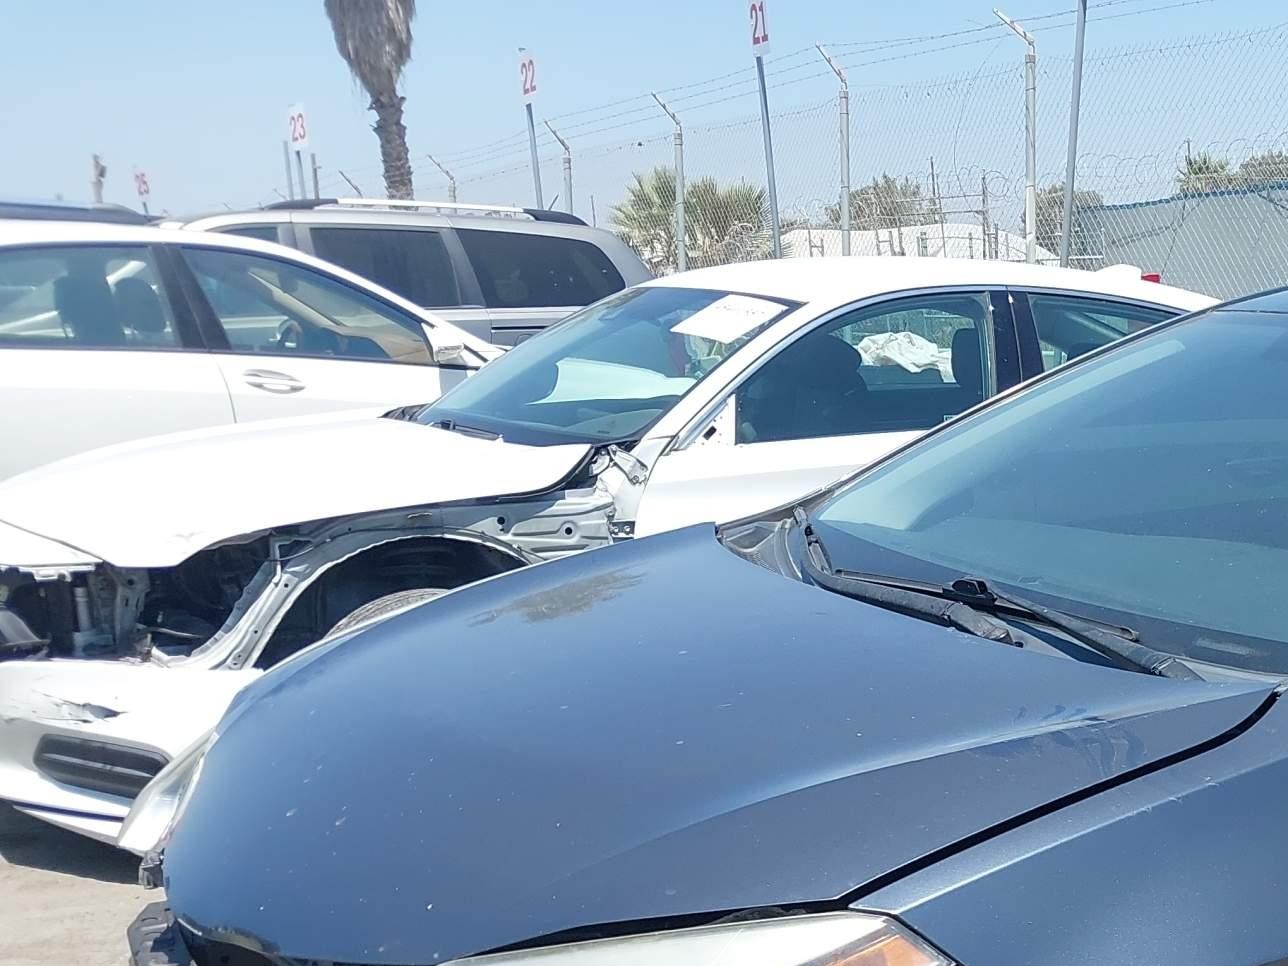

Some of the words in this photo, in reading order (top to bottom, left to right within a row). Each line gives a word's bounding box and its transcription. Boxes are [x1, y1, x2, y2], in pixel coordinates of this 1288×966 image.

[750, 1, 769, 45] 21
[520, 59, 537, 96] 22
[289, 112, 306, 142] 23
